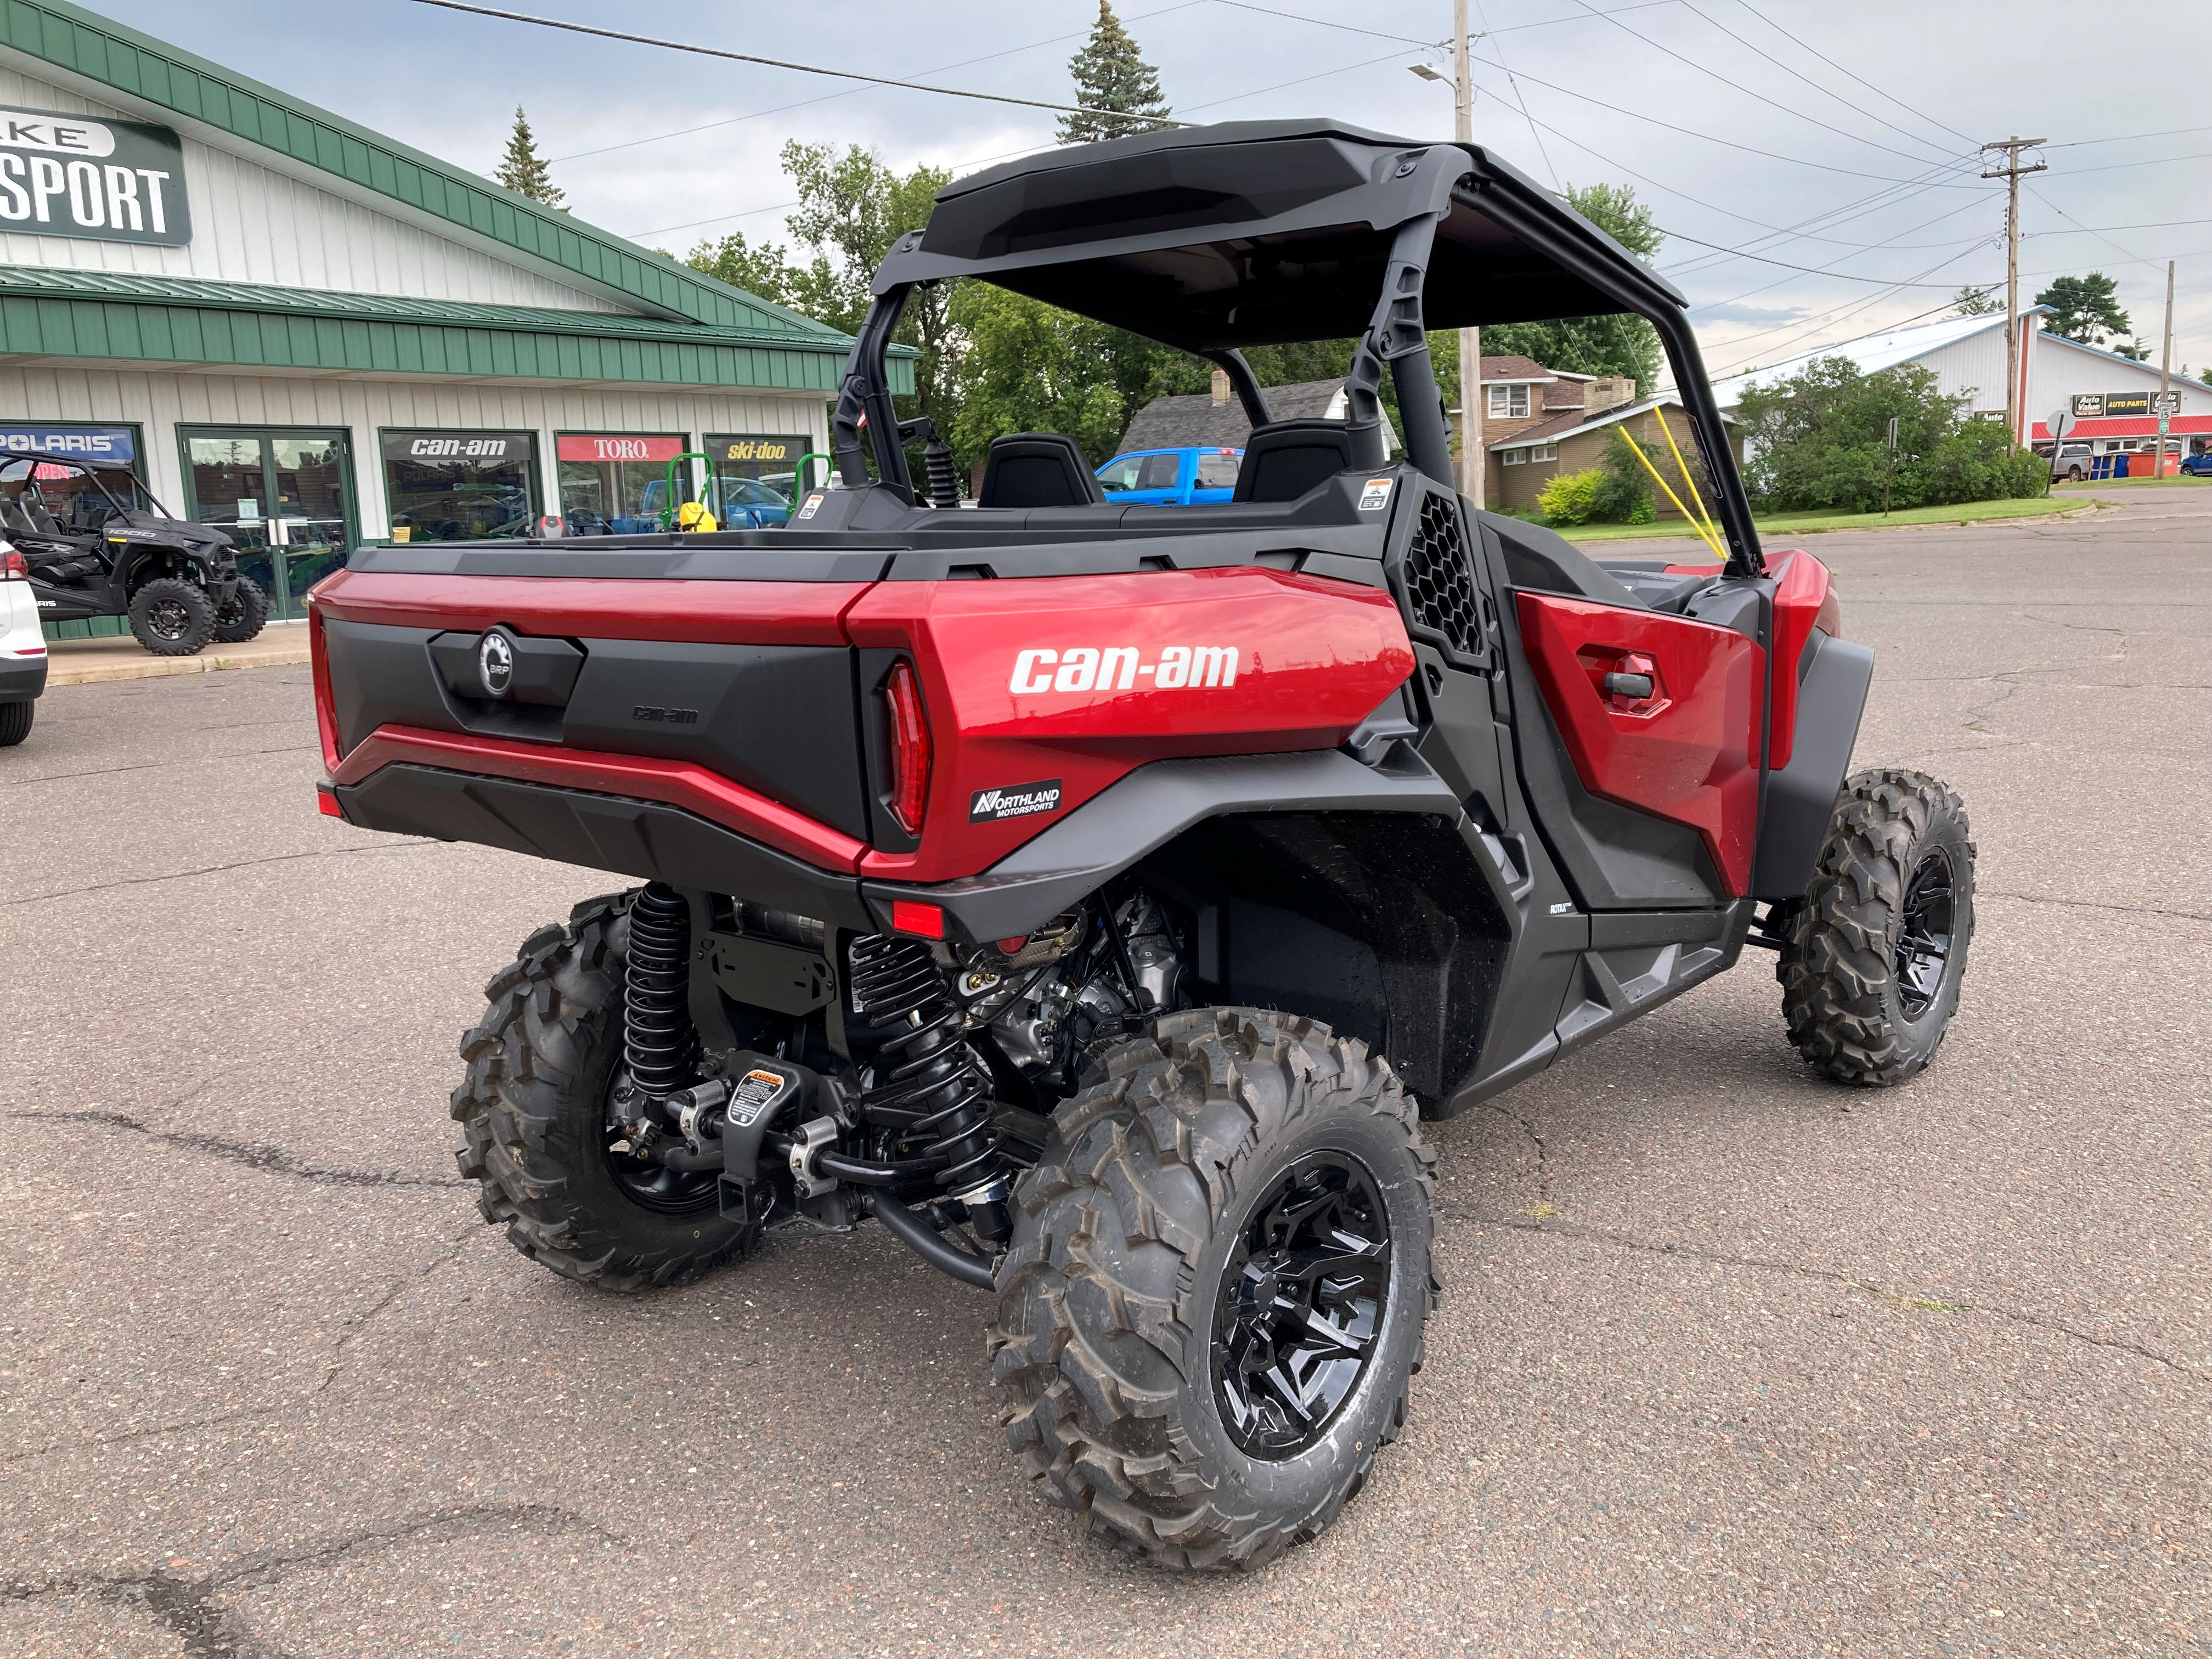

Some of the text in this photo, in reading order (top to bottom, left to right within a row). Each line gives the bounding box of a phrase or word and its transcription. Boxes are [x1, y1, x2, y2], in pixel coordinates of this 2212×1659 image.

[0, 120, 89, 149] KE
[411, 439, 506, 455] can-am
[594, 439, 647, 458] TORO
[727, 441, 786, 459] ski-doo
[108, 529, 156, 538] 1000
[490, 664, 509, 675] BRP
[1009, 646, 1239, 694] can-am
[633, 706, 698, 724] can-am
[996, 802, 1054, 818] MOTORSPORTS
[1550, 903, 1566, 914] ROTAX
